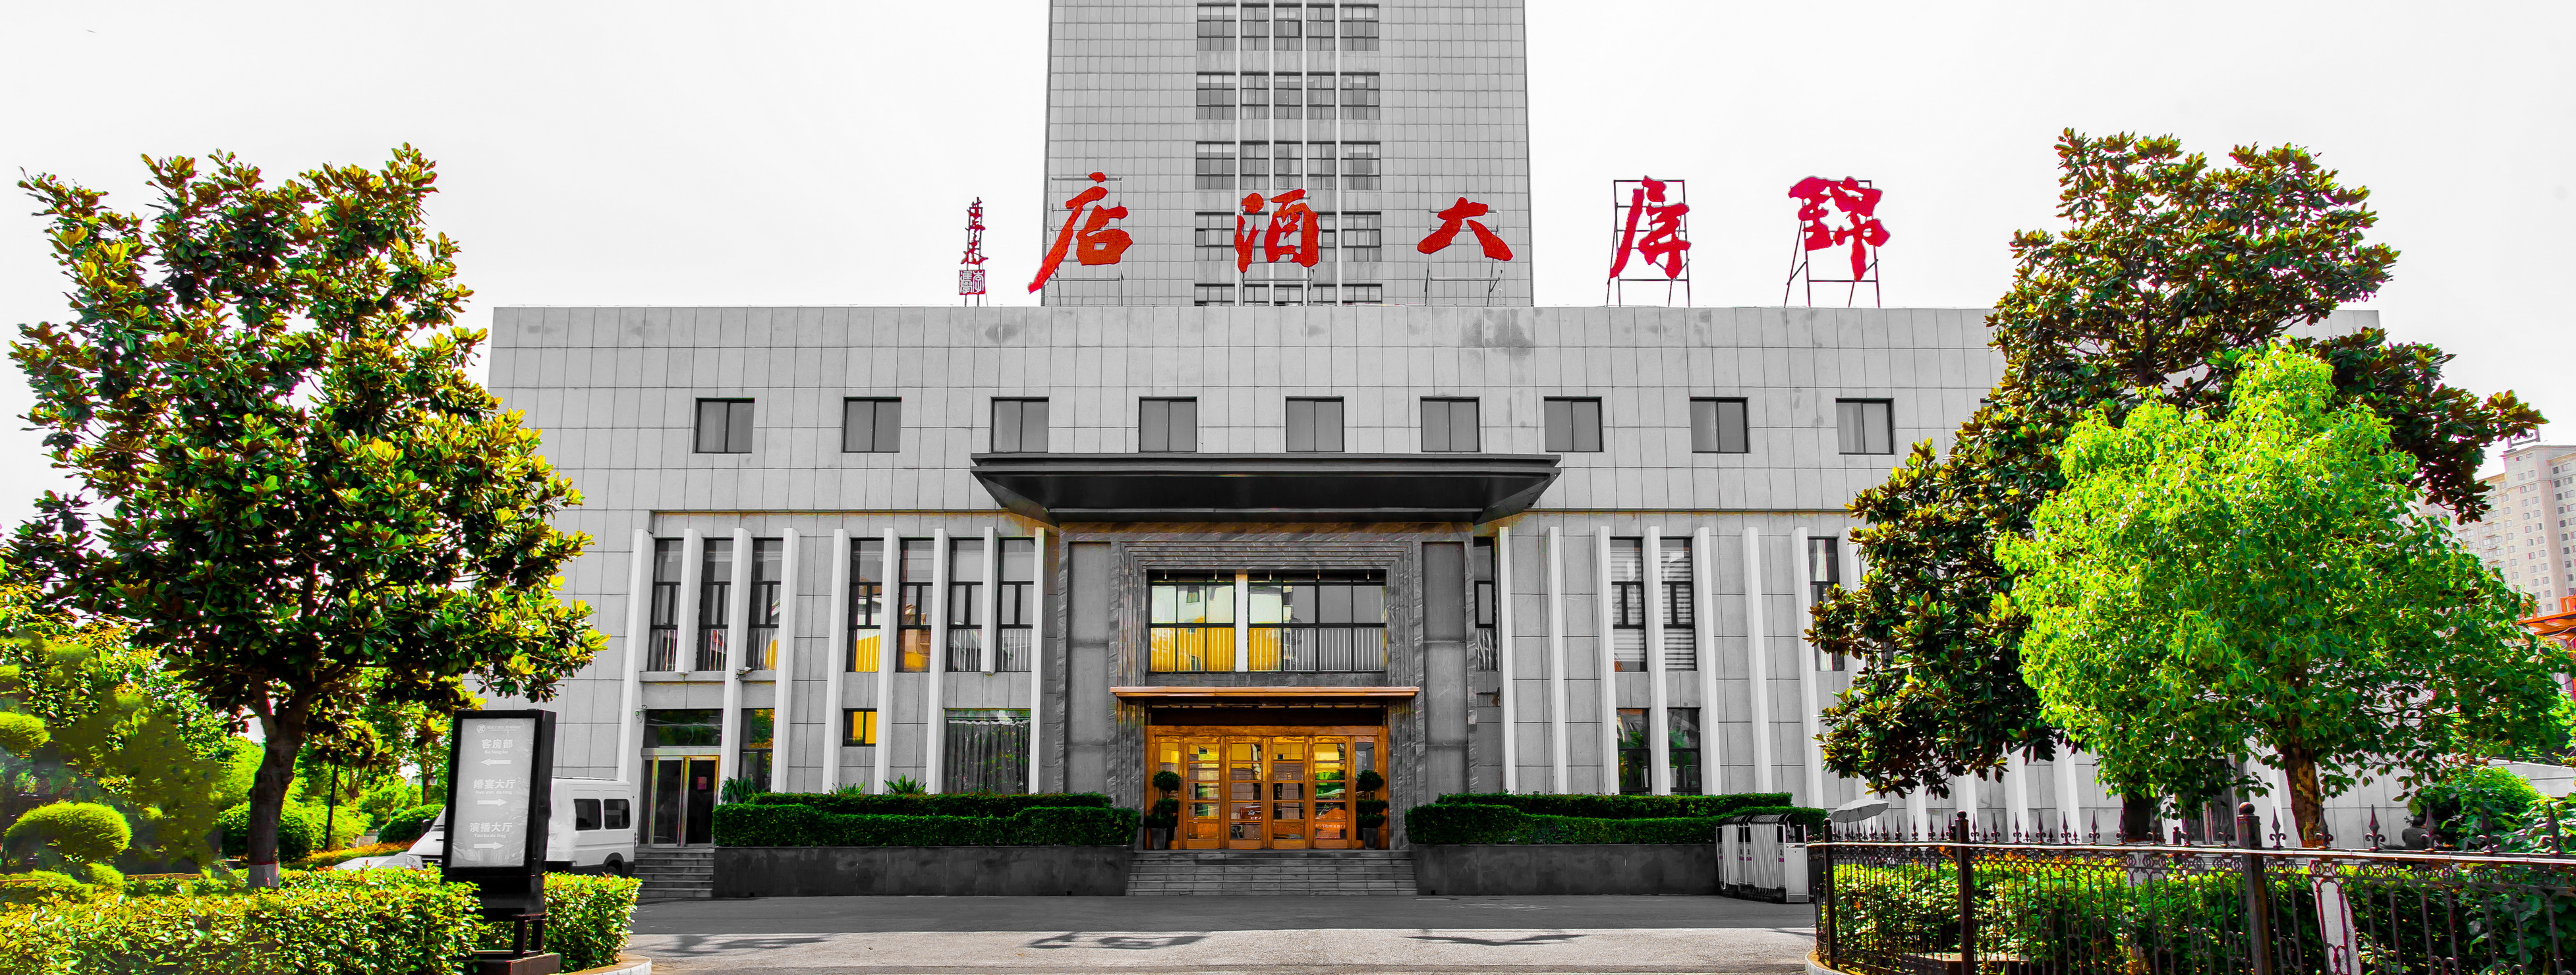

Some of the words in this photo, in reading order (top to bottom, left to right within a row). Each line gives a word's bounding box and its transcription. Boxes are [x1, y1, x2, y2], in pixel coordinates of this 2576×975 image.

[481, 739, 513, 749] 客房部
[473, 779, 516, 789] 婚宴大厅
[469, 822, 513, 833] 演播大厅
